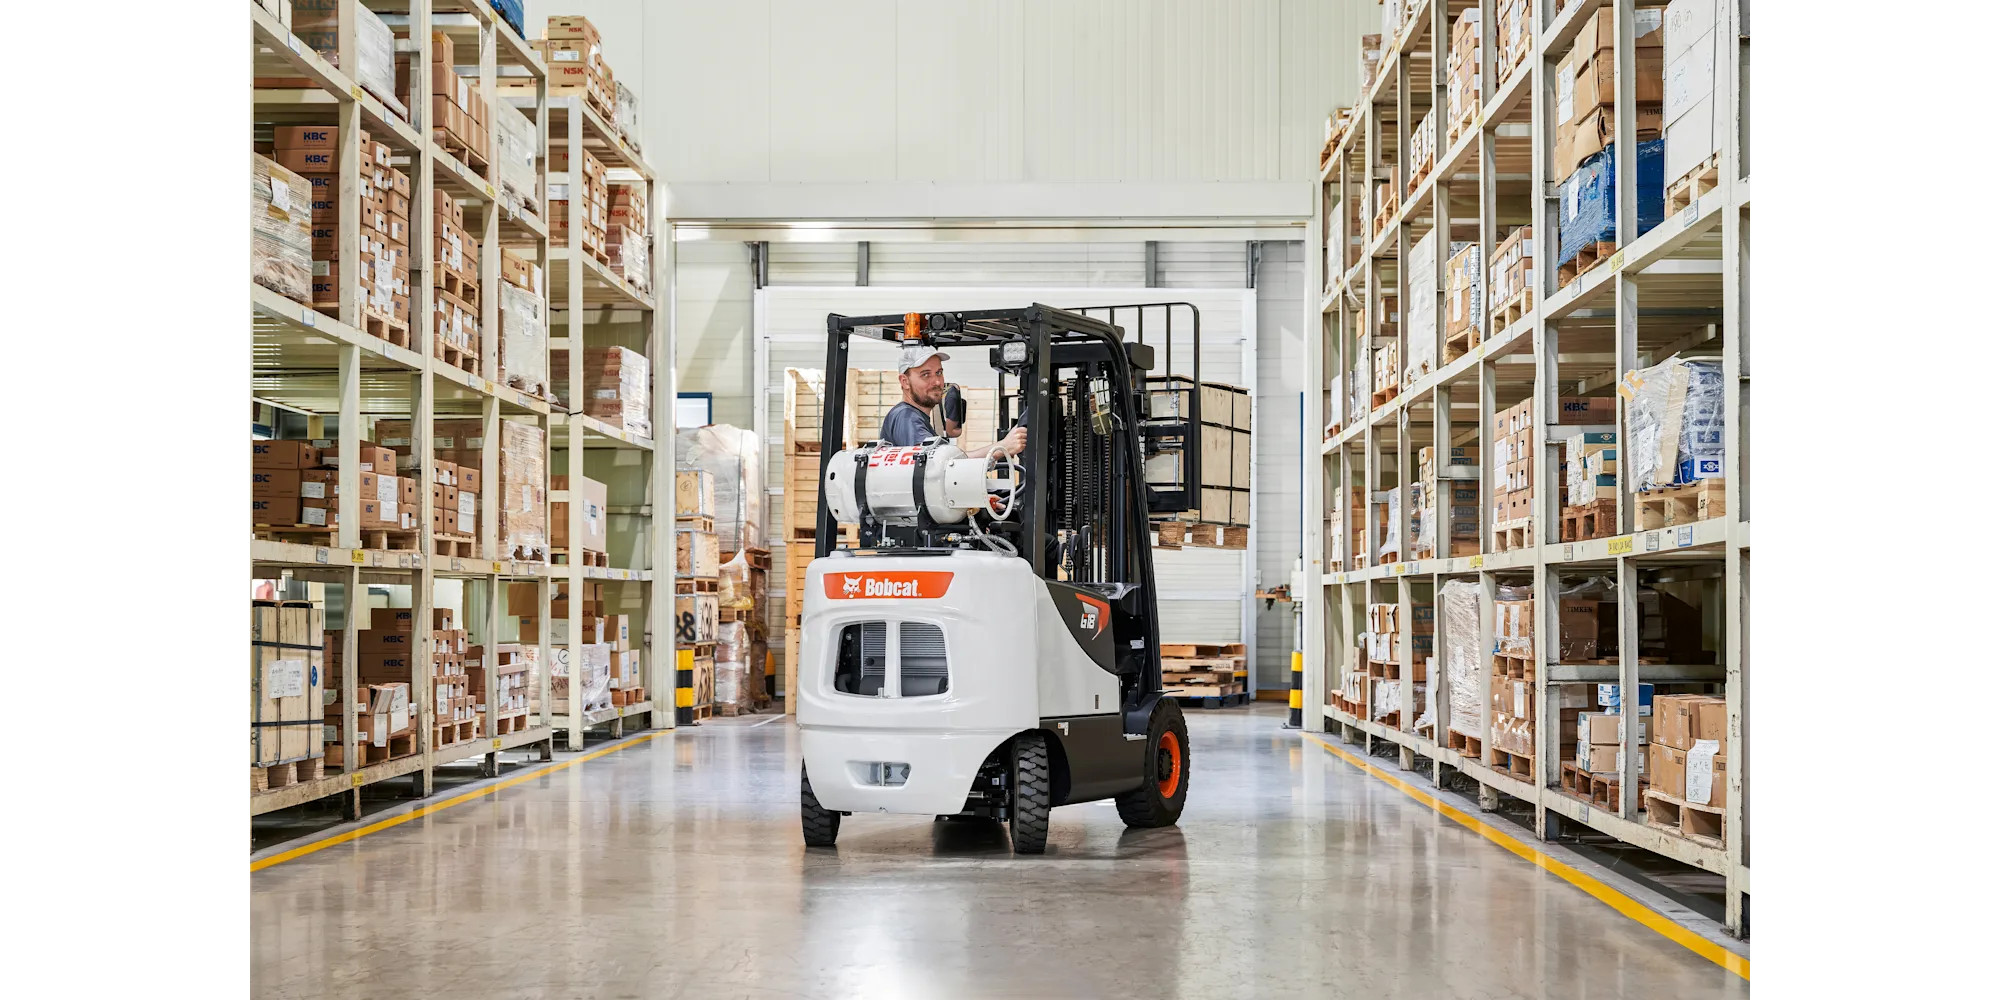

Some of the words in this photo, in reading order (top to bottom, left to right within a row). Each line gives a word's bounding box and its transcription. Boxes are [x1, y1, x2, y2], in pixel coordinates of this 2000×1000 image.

[563, 67, 585, 75] NSK
[1645, 107, 1663, 116] TIM
[303, 131, 328, 141] KBC
[305, 154, 330, 163] KBC
[1564, 402, 1589, 412] KBC
[253, 445, 271, 454] BC
[253, 474, 272, 483] BC
[253, 501, 270, 510] BC
[865, 578, 919, 597] Bobcat
[396, 612, 412, 620] KB
[383, 635, 405, 643] KBC
[383, 659, 406, 667] KBC
